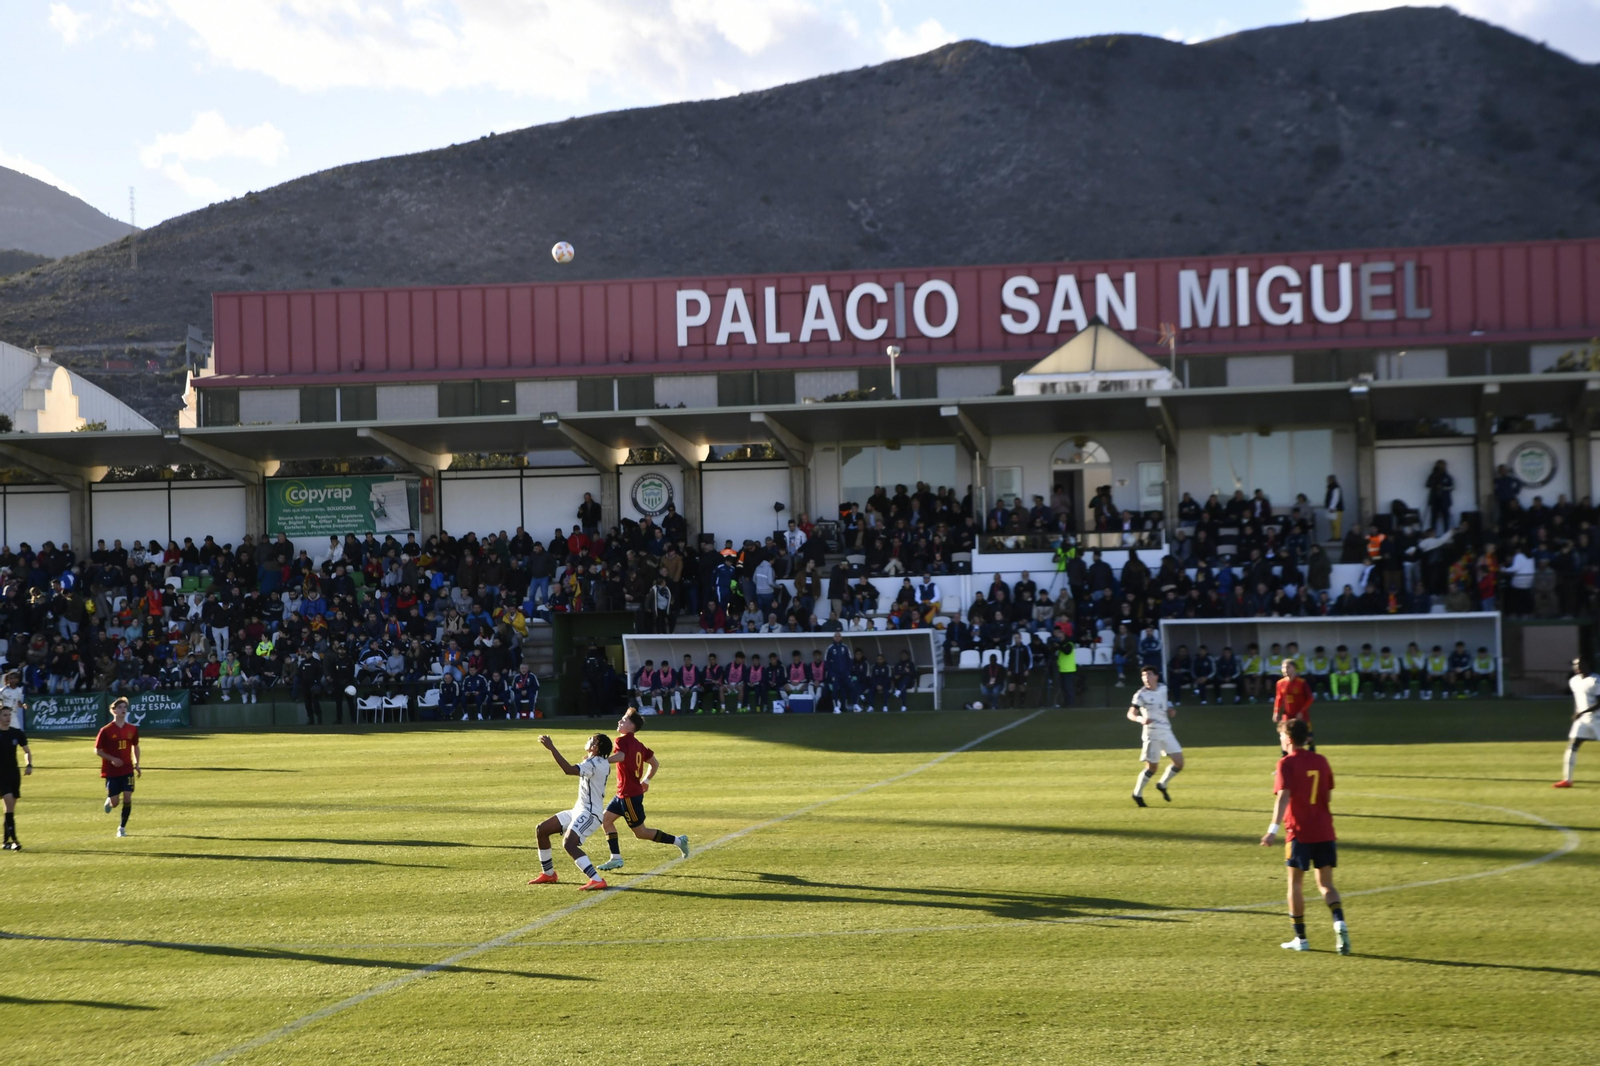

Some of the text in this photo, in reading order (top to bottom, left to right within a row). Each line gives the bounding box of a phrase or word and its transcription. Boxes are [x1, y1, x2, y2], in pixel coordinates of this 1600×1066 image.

[676, 260, 1432, 347] PALACIO SAN MIGUEL
[290, 487, 352, 503] copyrap
[65, 697, 94, 705] FRUTAS
[141, 694, 171, 703] HOTEL
[130, 702, 182, 711] PEZ ESPADA
[32, 711, 98, 725] Manantiales
[118, 740, 127, 750] 10
[635, 751, 643, 778] 9
[1306, 770, 1320, 805] 7
[577, 815, 587, 824] 5
[624, 811, 631, 822] 9
